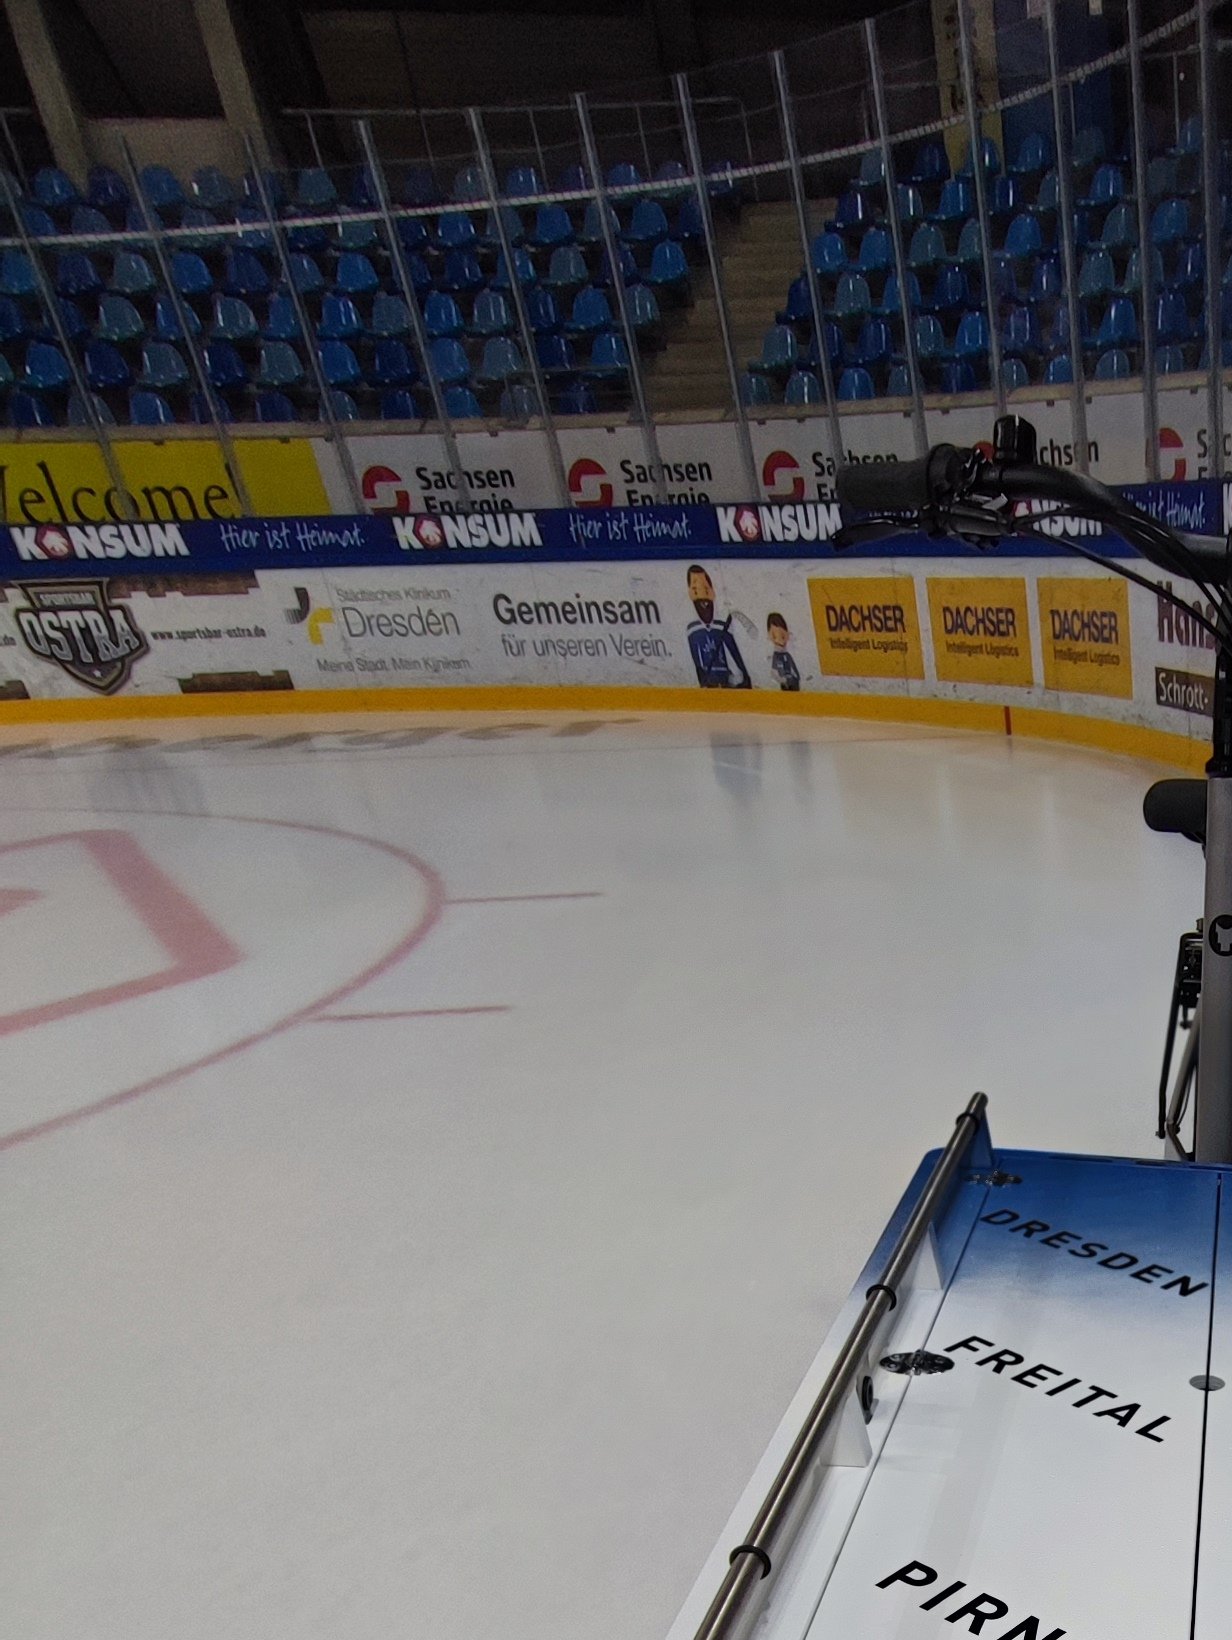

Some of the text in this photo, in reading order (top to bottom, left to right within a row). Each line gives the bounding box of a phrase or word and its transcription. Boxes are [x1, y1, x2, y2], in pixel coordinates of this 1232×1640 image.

[220, 524, 260, 553] Hier
[264, 522, 291, 549] ist
[342, 606, 461, 638] Dresden
[493, 593, 662, 626] Gemeinsam
[825, 605, 907, 634] DACHSER
[942, 606, 1017, 638] DACHSER
[18, 608, 140, 664] OSTRA
[1050, 609, 1119, 645] DACHSER
[502, 633, 673, 661] für unseren Verein.
[980, 1208, 1209, 1298] DRESDEN
[943, 1335, 1174, 1443] FREITAL
